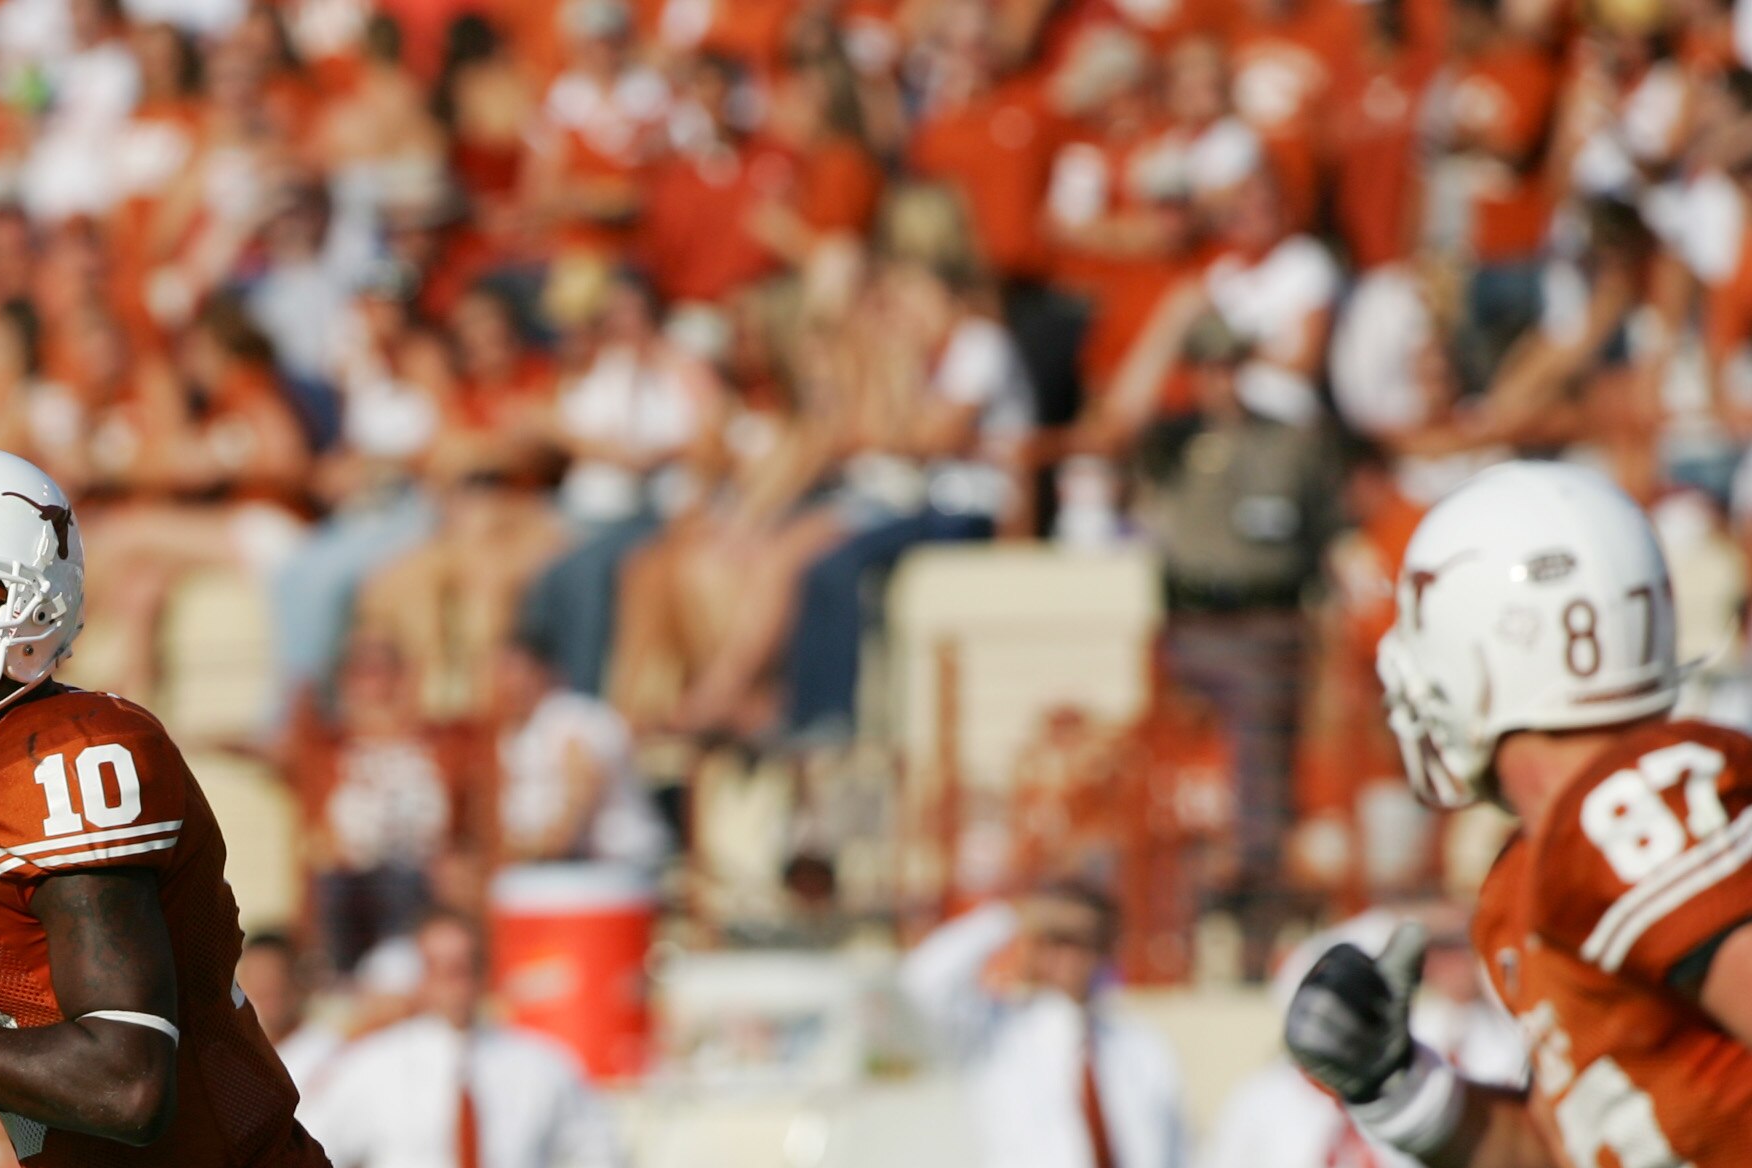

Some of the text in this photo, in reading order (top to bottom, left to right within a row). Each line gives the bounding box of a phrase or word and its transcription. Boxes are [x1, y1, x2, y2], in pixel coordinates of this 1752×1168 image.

[1562, 581, 1654, 678] 87
[33, 743, 142, 837] 10
[1578, 740, 1730, 885] 87
